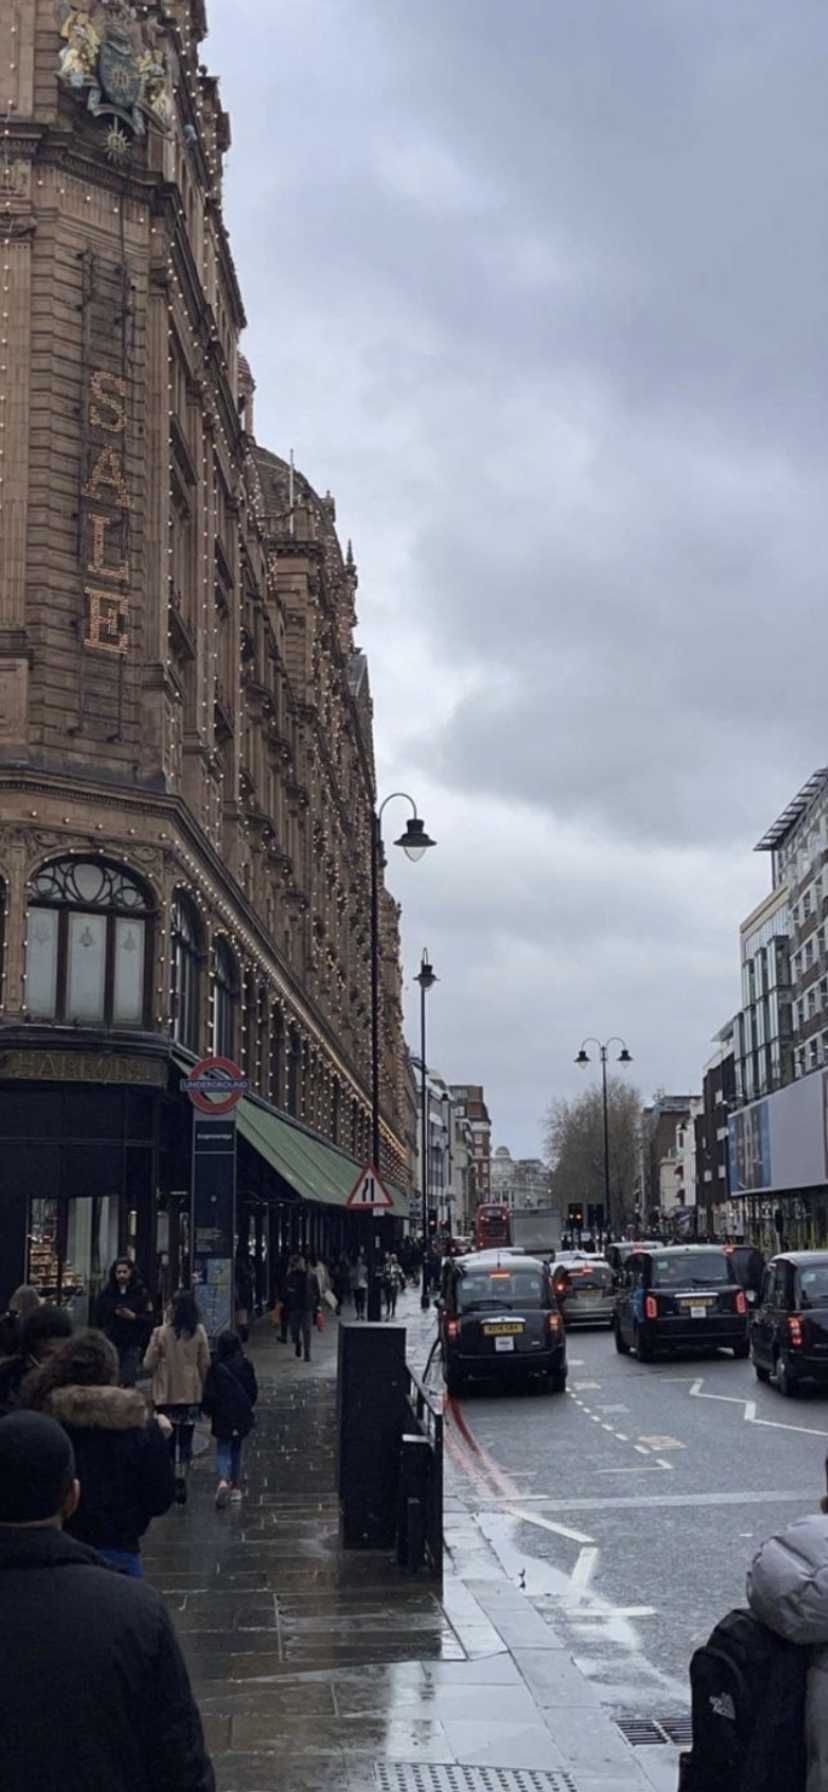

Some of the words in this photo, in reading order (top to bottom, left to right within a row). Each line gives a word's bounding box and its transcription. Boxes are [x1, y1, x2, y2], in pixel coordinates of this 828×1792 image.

[81, 370, 134, 655] SALE
[13, 1053, 141, 1079] HARRODS
[183, 1081, 248, 1089] UNDERGROUND
